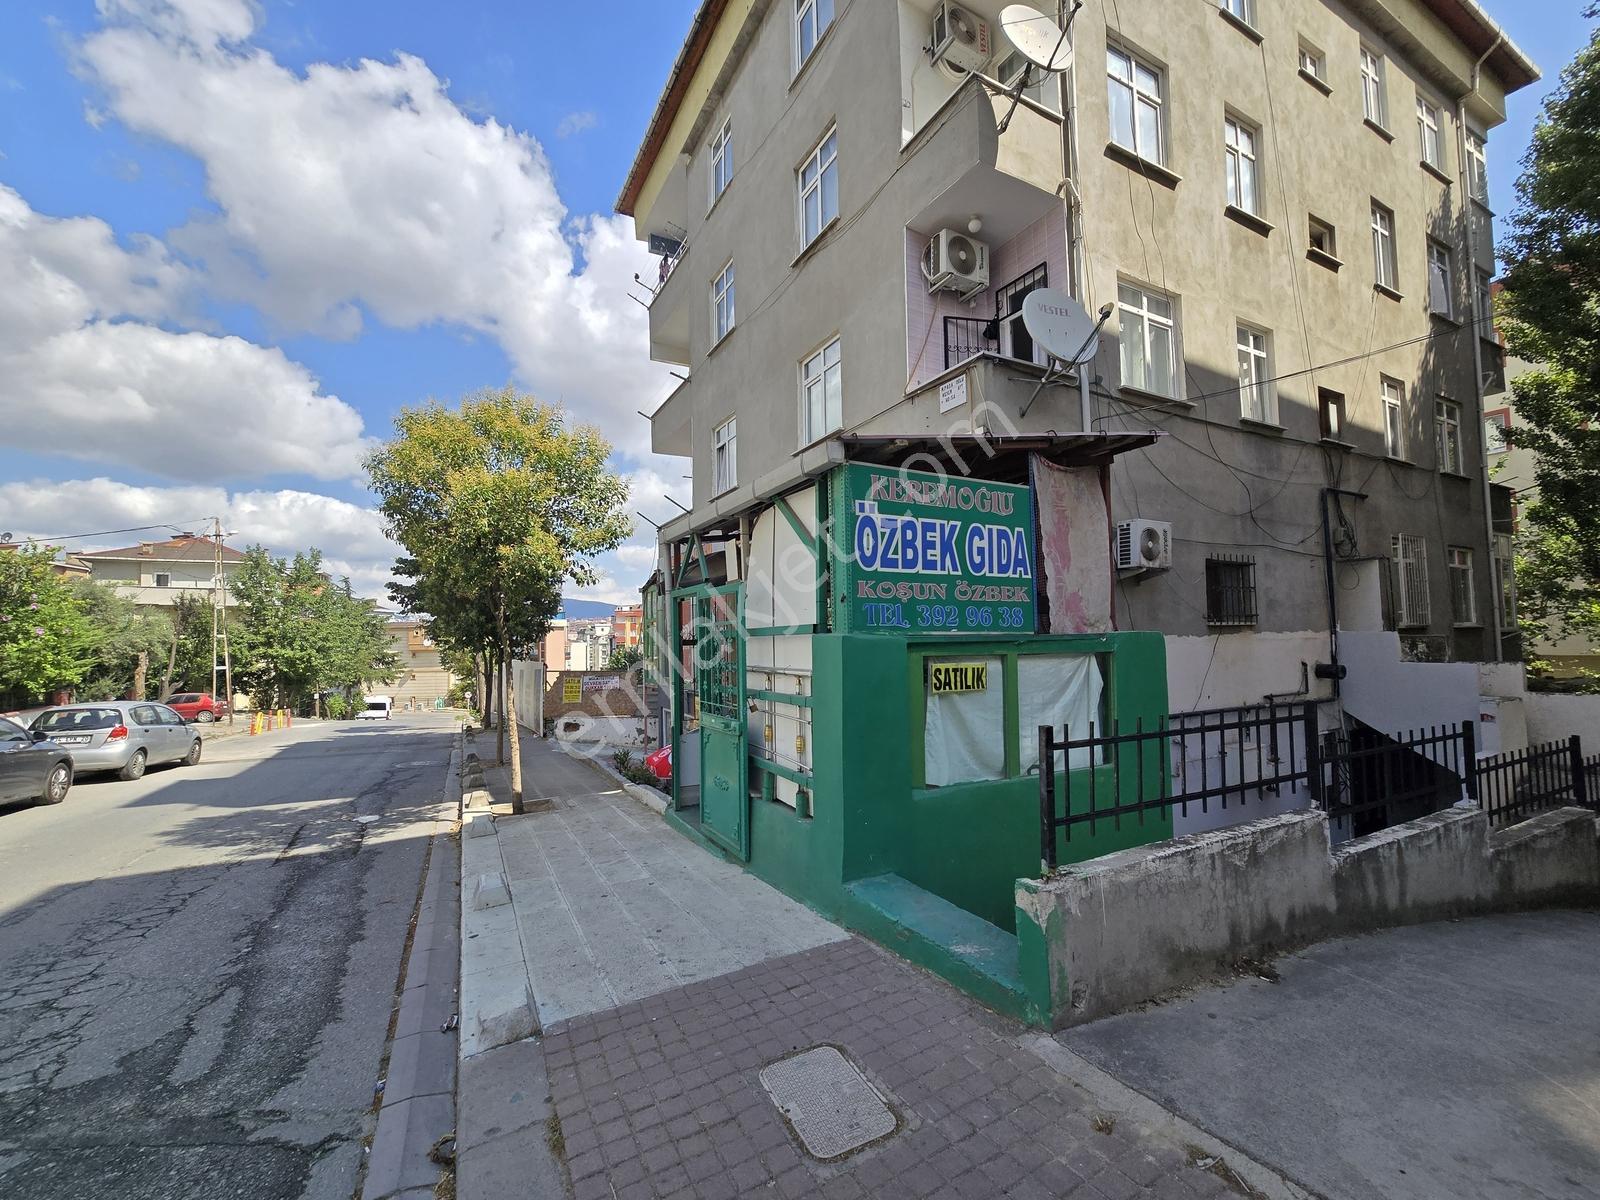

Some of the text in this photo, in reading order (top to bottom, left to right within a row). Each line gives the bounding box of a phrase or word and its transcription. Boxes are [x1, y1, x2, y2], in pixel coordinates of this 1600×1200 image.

[1038, 303, 1071, 318] VESTEL
[855, 500, 1032, 579] ÖZBEK GIDA
[857, 580, 1031, 603] KOŞUN ÖZBEK
[916, 604, 960, 627] 392
[965, 606, 993, 628] 96
[997, 606, 1024, 628] 38
[933, 667, 985, 692] SATILIK
